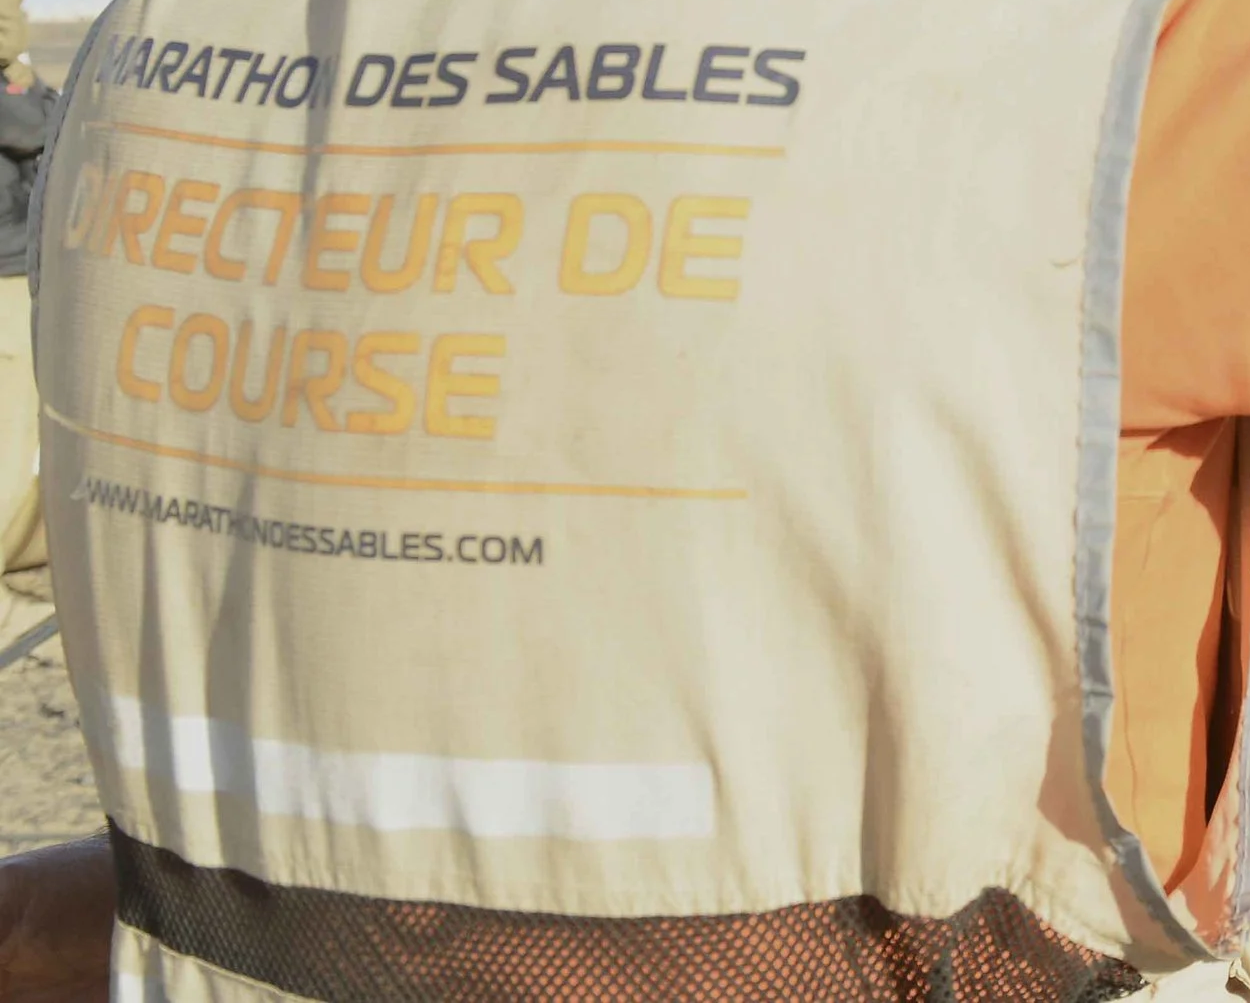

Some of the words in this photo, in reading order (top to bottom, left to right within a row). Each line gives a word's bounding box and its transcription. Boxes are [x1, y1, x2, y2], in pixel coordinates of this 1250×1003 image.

[96, 34, 340, 109] MARATHON
[344, 52, 478, 108] DES
[484, 43, 807, 107] SABLES
[65, 161, 526, 296] DIRECTEUR
[557, 192, 751, 302] DE
[115, 304, 508, 441] COURSE
